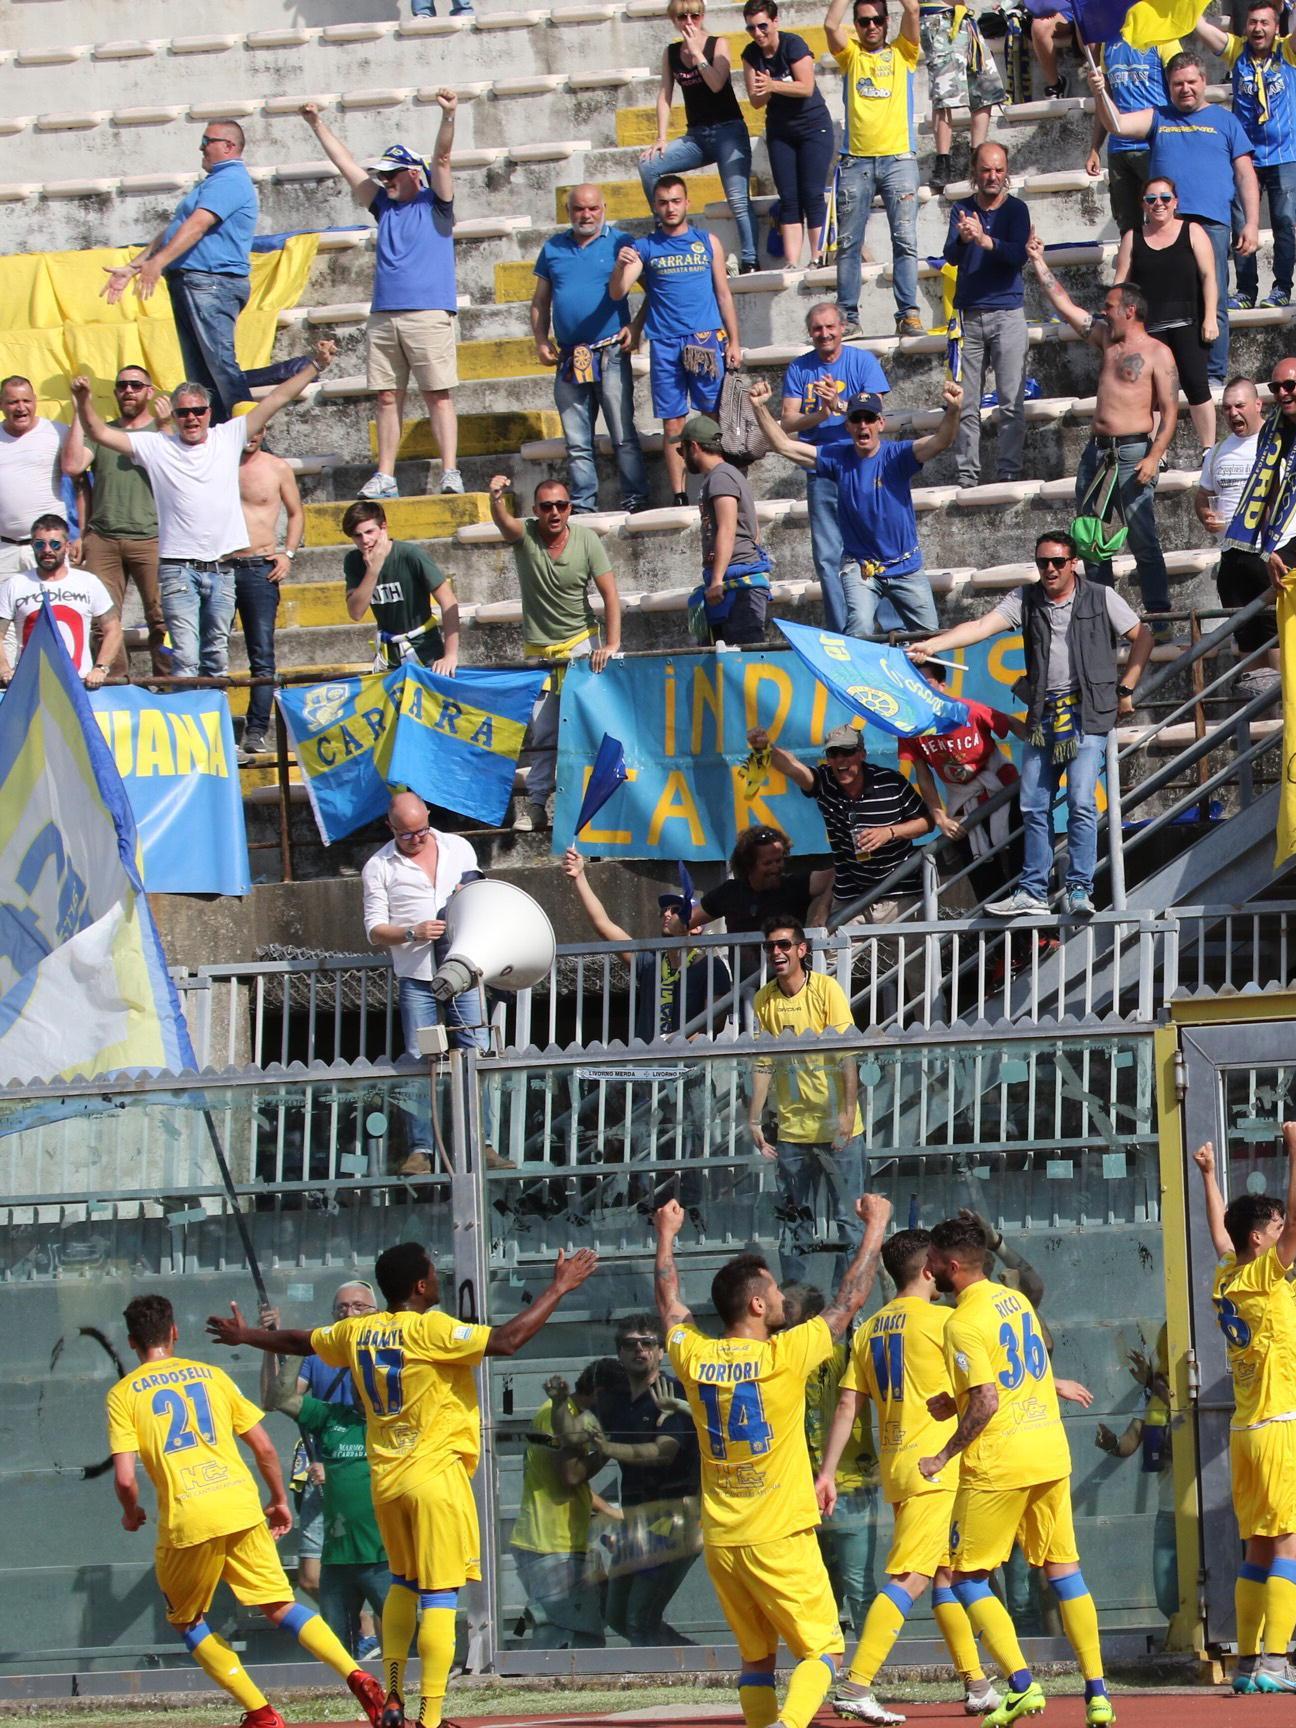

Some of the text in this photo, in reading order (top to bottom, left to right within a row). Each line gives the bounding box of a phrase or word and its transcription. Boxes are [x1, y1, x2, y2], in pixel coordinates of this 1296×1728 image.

[315, 686, 494, 767] CARRARA
[588, 1069, 614, 1078] LIVORNO
[615, 1069, 637, 1078] MERDA
[652, 1069, 678, 1078] LIVORNO
[873, 1313, 907, 1333] BIASCI
[994, 1296, 1022, 1320] RICCI
[132, 1366, 213, 1394] CARDOSELLI
[357, 1349, 405, 1417] 17
[698, 1361, 760, 1383] TORTORI
[869, 1332, 905, 1403] 11
[998, 1311, 1049, 1391] 36
[151, 1381, 218, 1456] 21
[697, 1381, 775, 1461] 14
